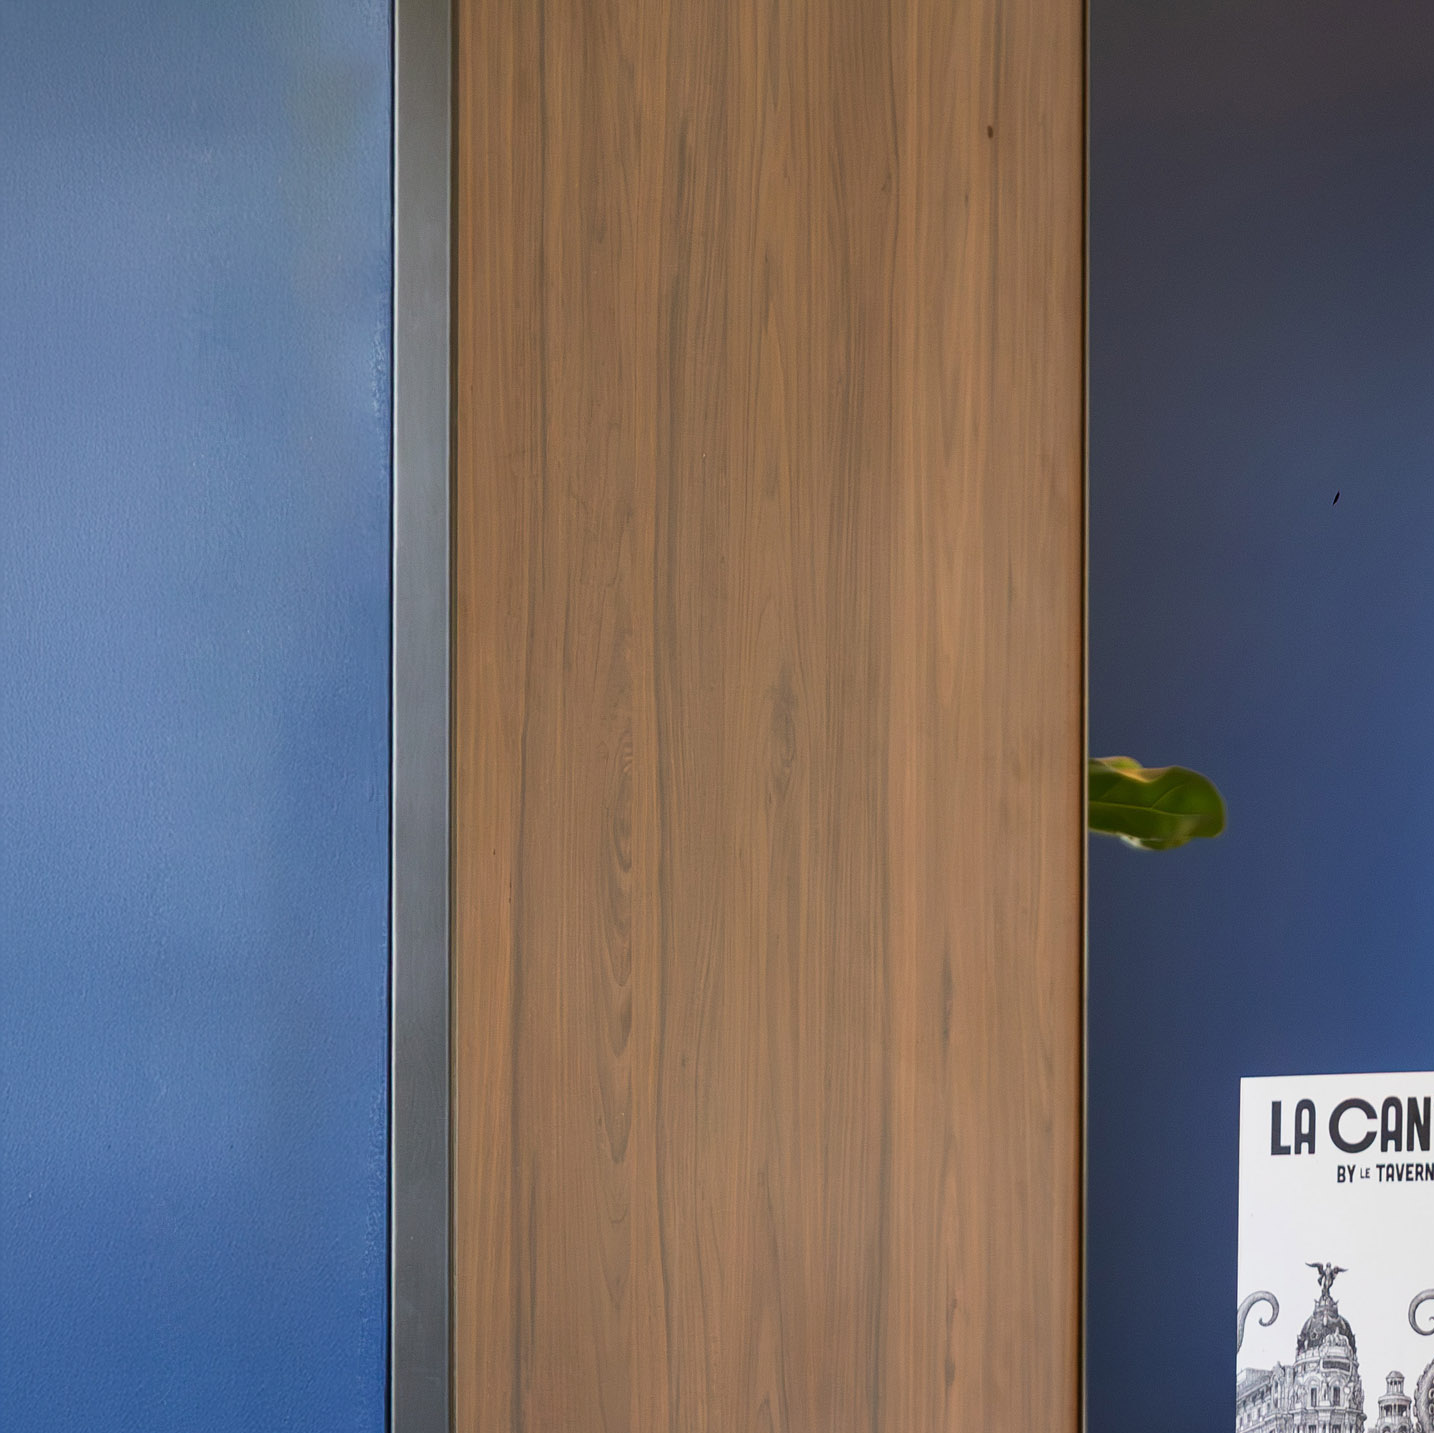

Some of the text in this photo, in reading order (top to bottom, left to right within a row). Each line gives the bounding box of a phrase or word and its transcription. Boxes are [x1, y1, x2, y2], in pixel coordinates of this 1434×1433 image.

[1270, 1098, 1316, 1156] LA
[1336, 1164, 1356, 1184] BY
[1359, 1167, 1371, 1179] LE
